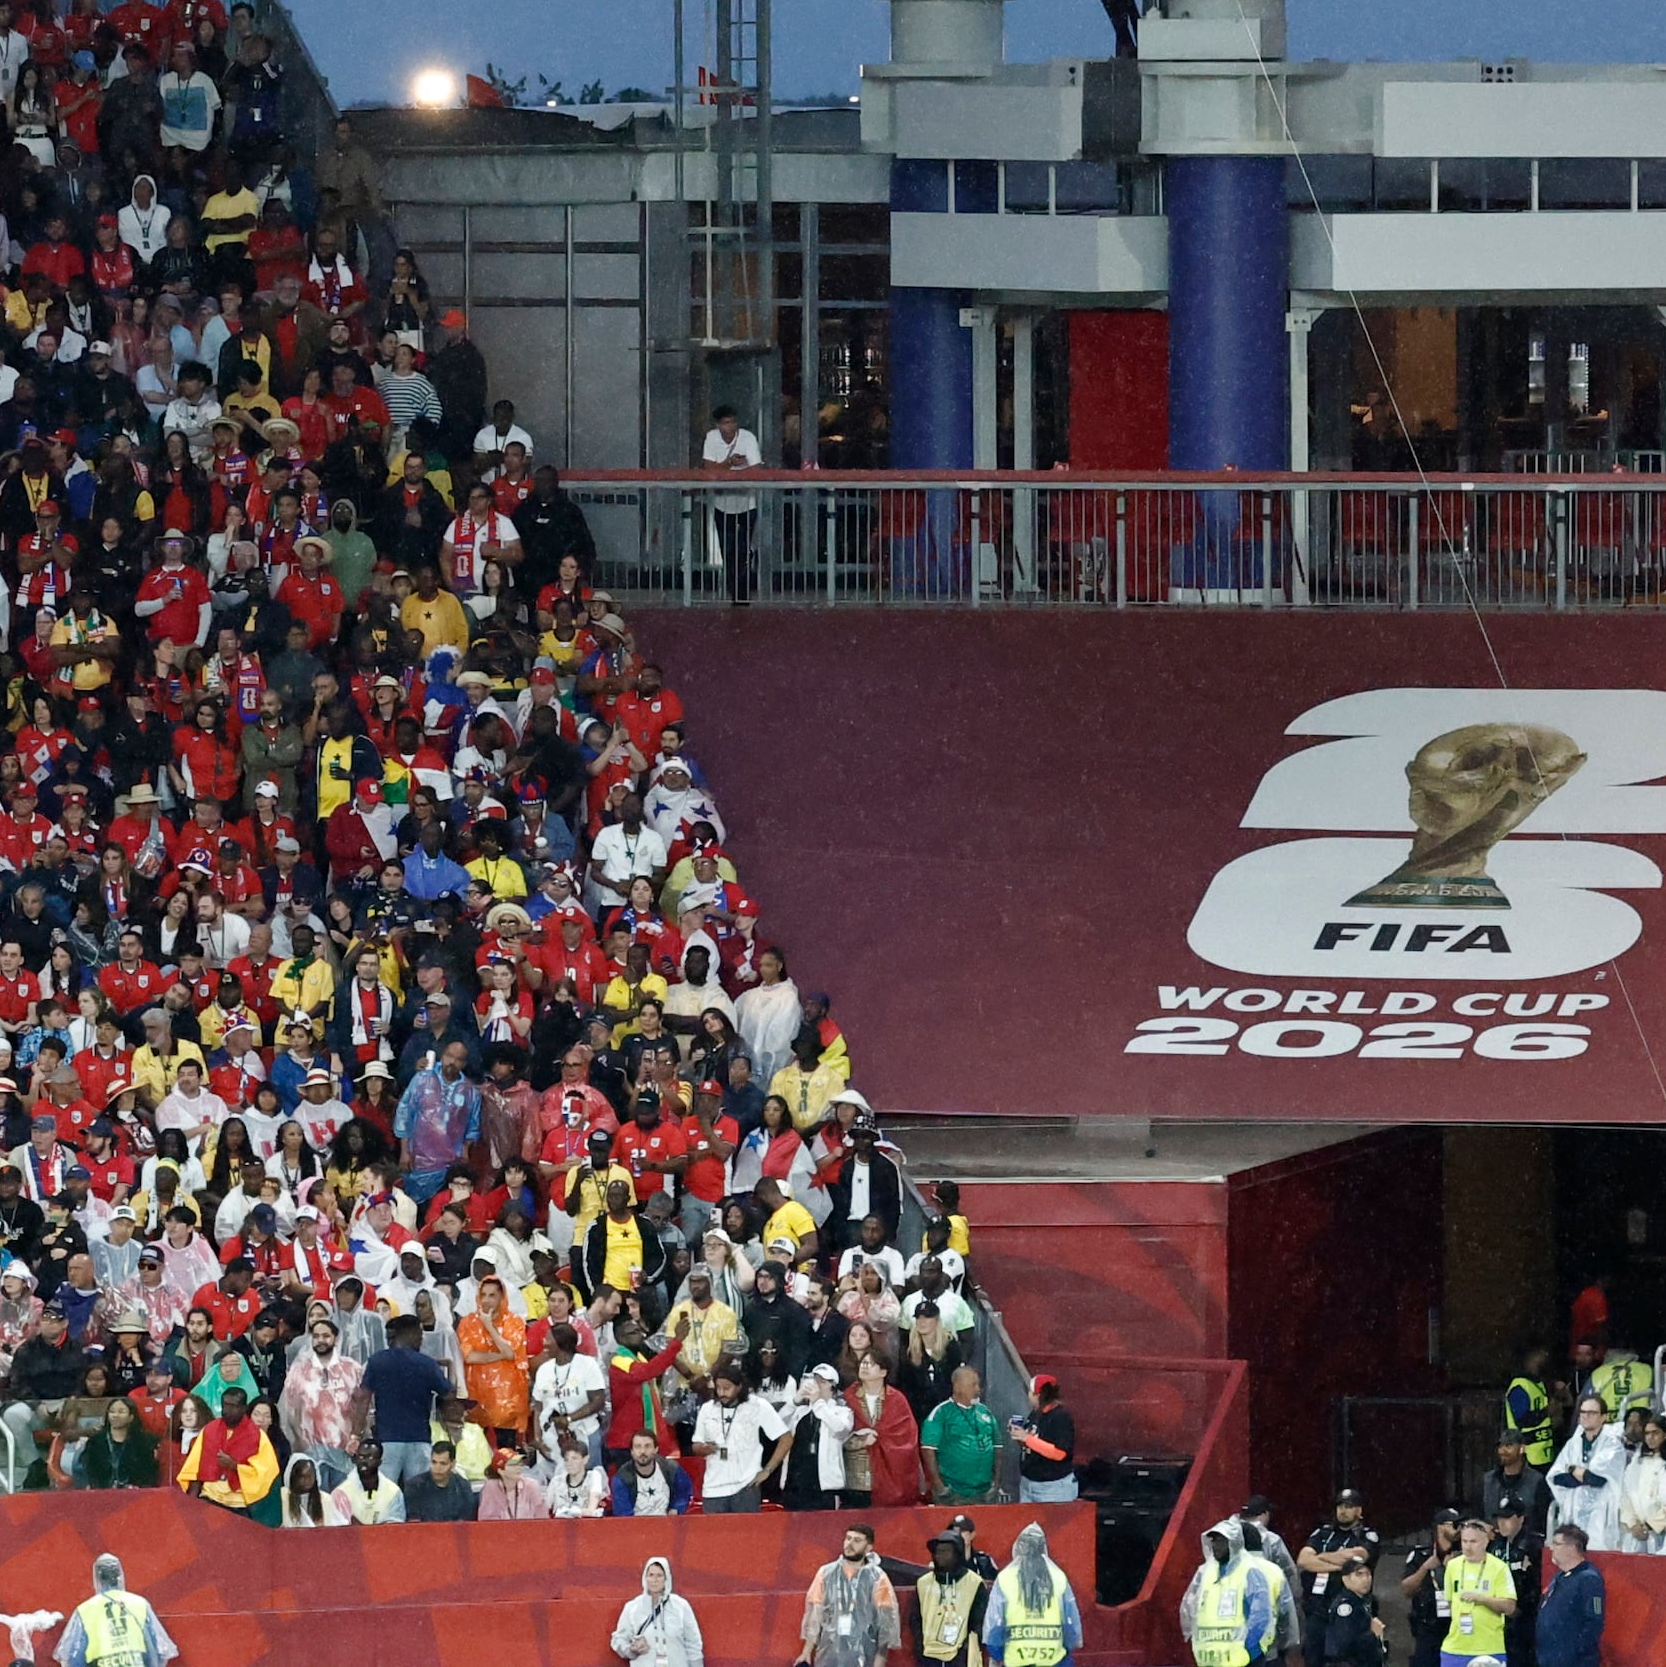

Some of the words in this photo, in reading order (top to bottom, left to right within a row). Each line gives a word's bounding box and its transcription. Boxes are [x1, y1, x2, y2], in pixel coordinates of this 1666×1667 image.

[1314, 922, 1511, 953] FIFA
[1157, 985, 1438, 1015] WORLD
[1452, 992, 1610, 1017] CUP
[1123, 1016, 1592, 1060] 2026
[1010, 1626, 1062, 1640] SECURITY
